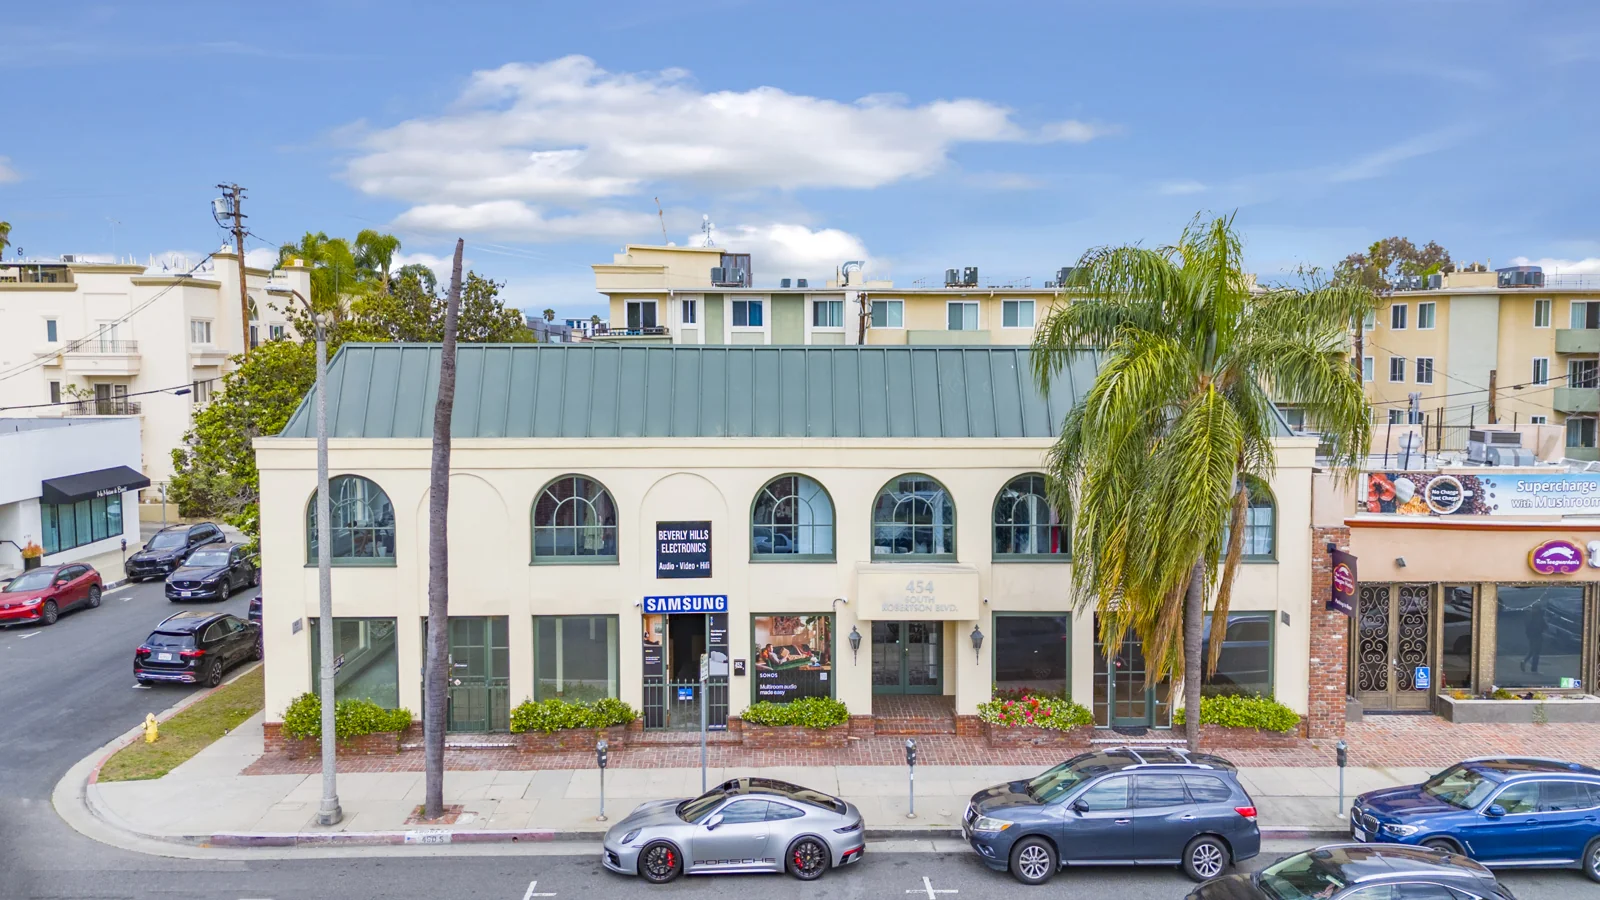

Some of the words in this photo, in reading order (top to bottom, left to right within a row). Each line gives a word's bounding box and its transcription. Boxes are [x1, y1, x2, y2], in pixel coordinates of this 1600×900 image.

[1517, 480, 1597, 494] Supercharge
[1511, 500, 1532, 508] With
[658, 530, 687, 540] BEVERLY
[690, 530, 708, 540] HILLS
[662, 543, 706, 553] ELECTRONICS
[906, 580, 934, 594] 454
[647, 597, 724, 611] SAMSUNG
[882, 604, 932, 612] ROBERTSON
